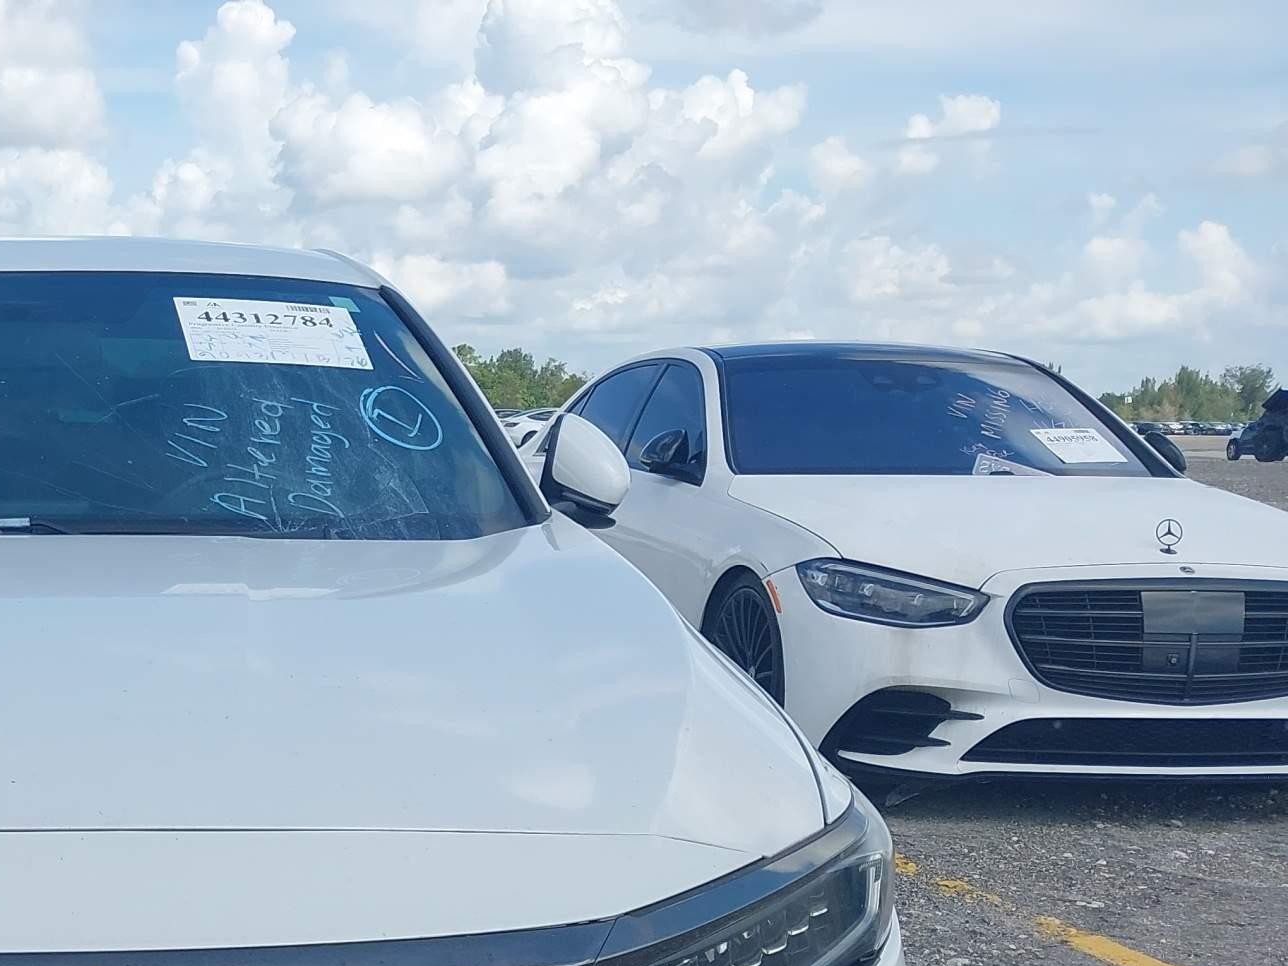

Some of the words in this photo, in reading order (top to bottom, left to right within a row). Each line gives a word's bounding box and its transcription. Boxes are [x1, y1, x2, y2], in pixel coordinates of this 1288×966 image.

[197, 311, 333, 328] 44312784
[947, 393, 976, 419] VIN
[980, 388, 1011, 440] MISSING
[165, 403, 229, 468] VIN
[210, 397, 295, 520] Altered
[287, 396, 350, 518] Damaged
